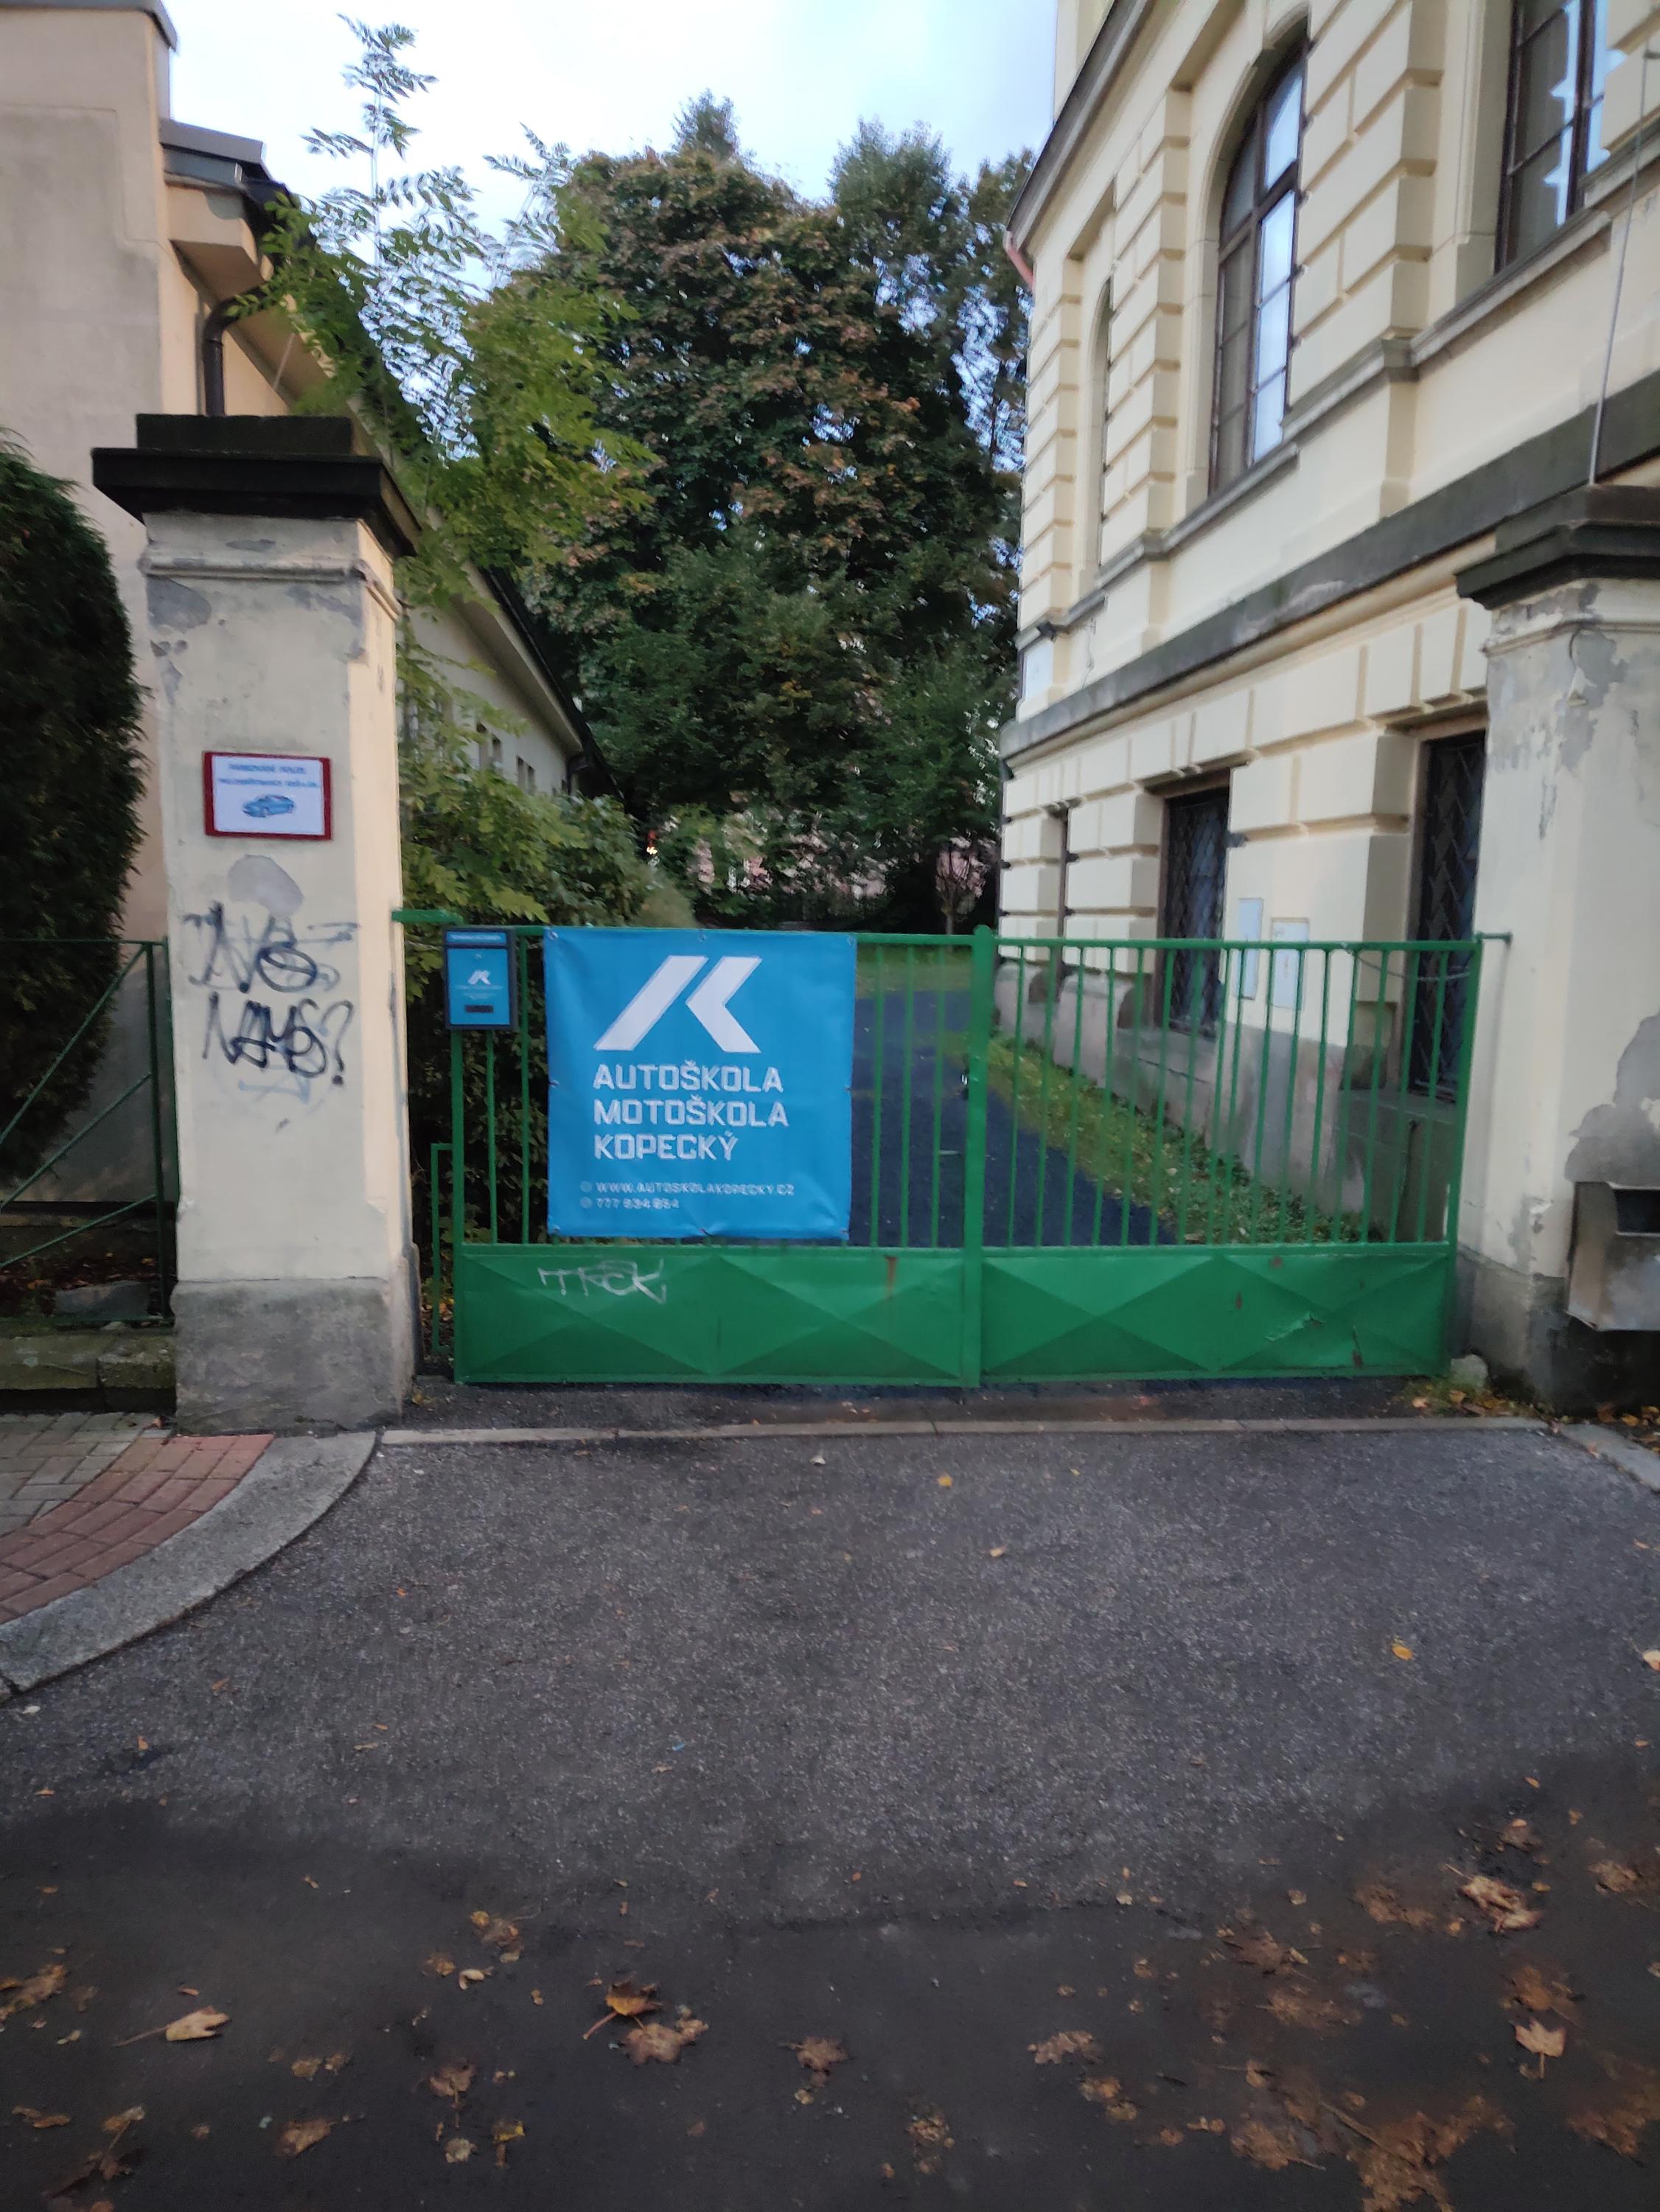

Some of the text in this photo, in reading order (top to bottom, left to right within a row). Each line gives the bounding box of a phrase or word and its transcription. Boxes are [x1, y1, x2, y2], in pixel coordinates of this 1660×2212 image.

[593, 1060, 784, 1093] AUTOŠKOLA
[593, 1094, 789, 1127] MOTOŠKOLA
[594, 1130, 739, 1161] KOPECKÝ
